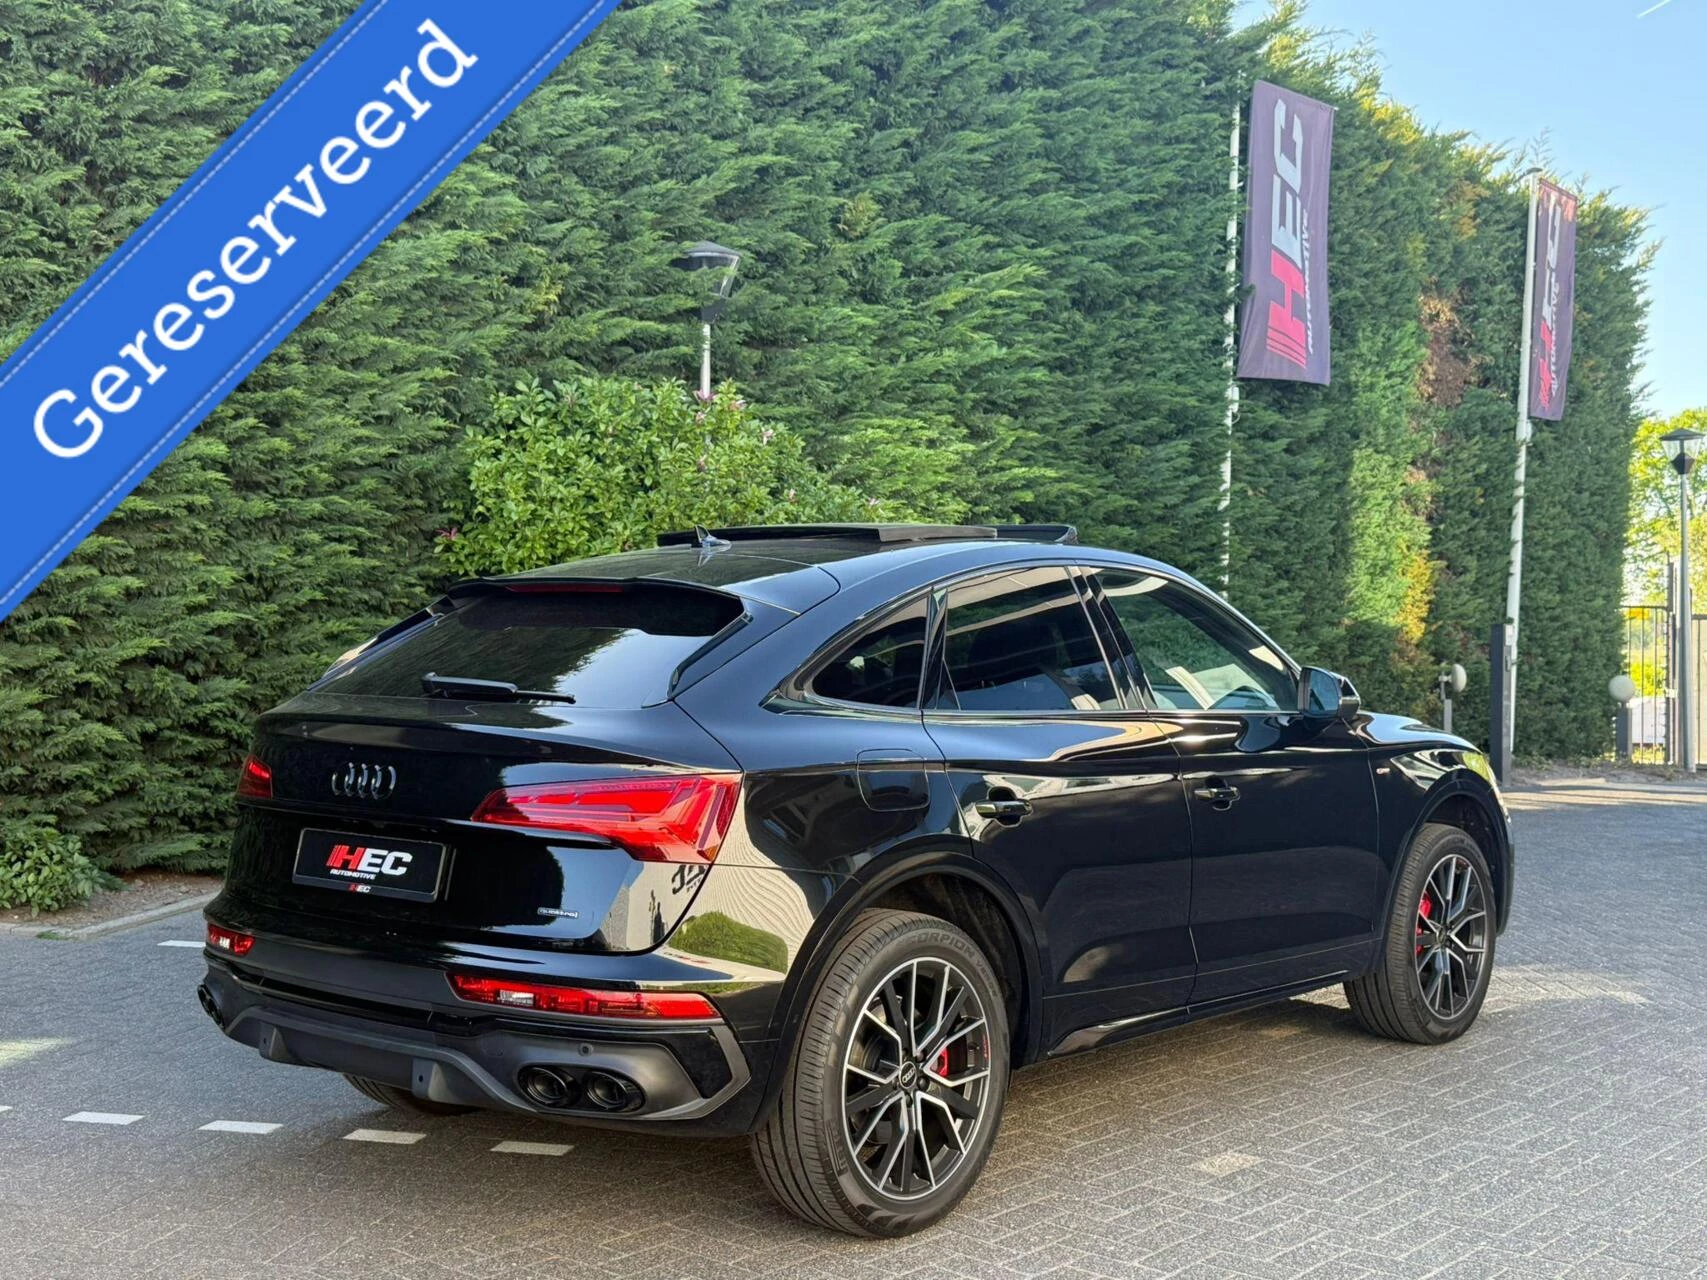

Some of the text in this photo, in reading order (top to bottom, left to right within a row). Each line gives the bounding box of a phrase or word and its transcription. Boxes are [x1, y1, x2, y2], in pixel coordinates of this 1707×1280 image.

[1266, 99, 1306, 368] HEC
[326, 844, 413, 876] HEC
[330, 868, 376, 880] AUTOMOTIVE
[348, 883, 371, 893] HEC
